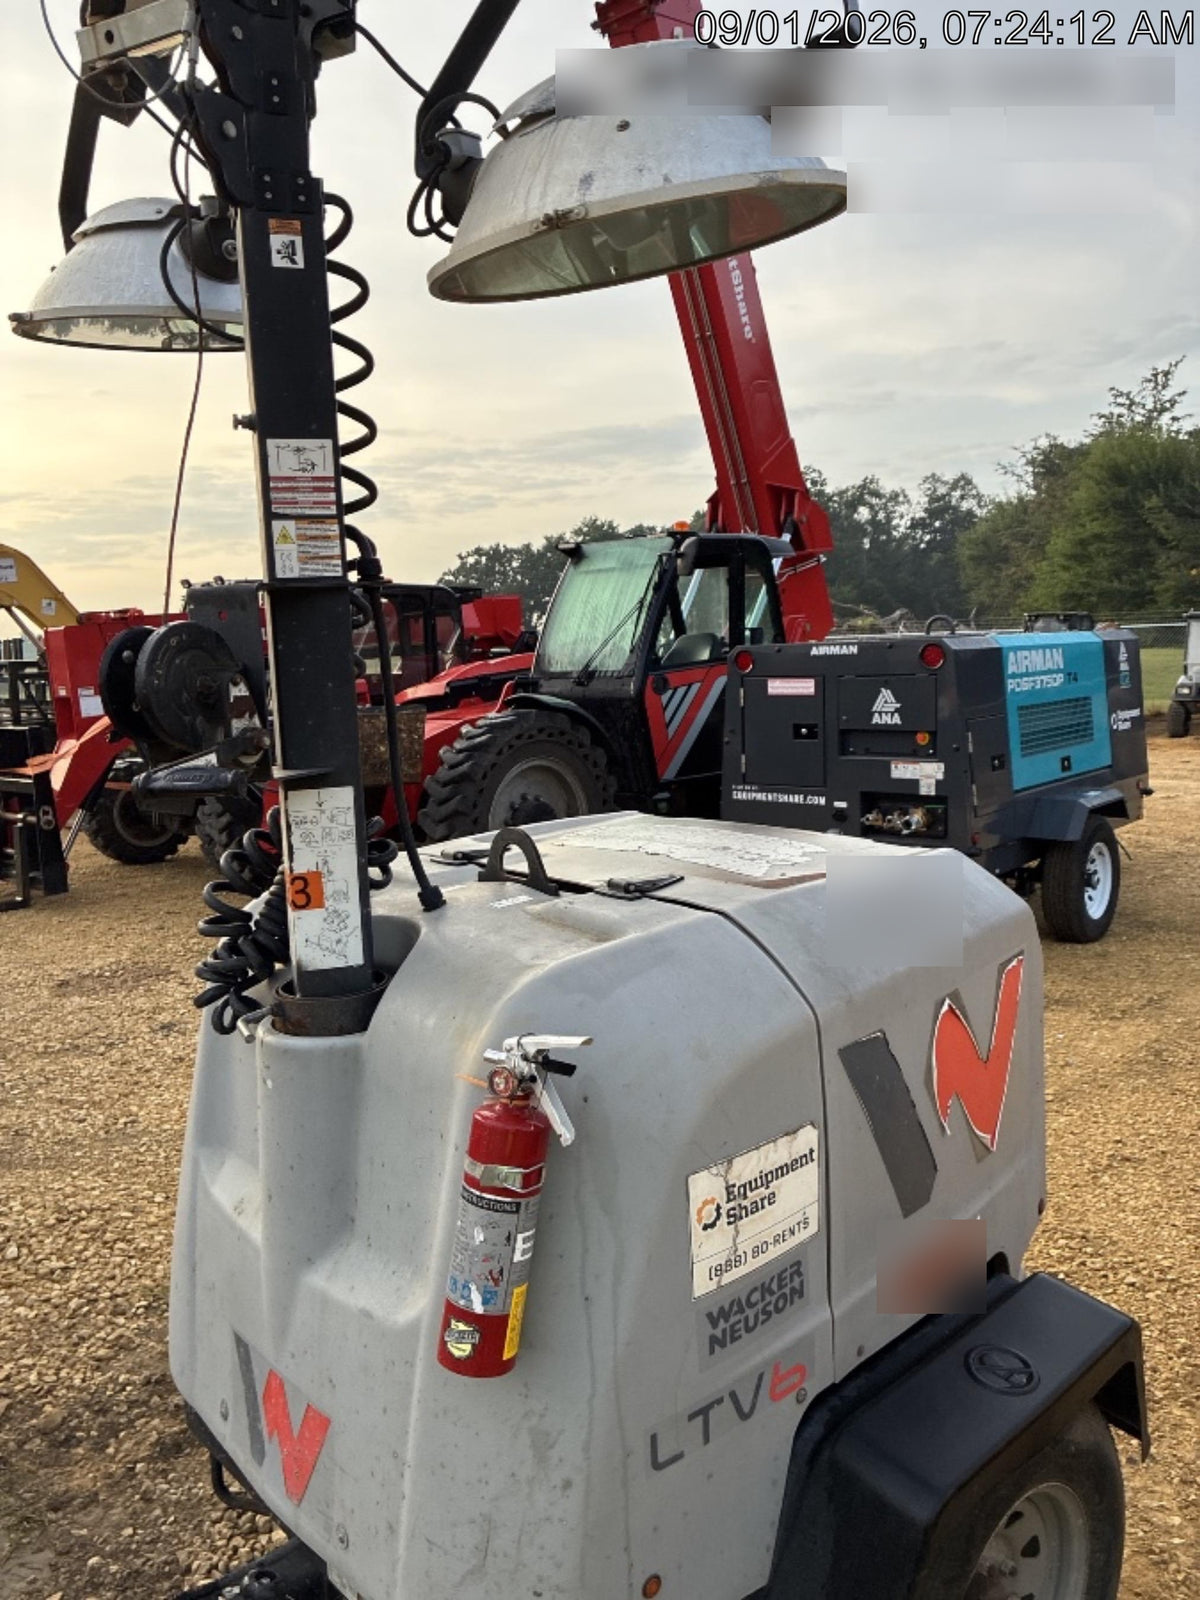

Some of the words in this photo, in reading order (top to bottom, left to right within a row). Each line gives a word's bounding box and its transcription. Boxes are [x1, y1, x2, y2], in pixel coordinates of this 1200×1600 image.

[727, 257, 753, 340] tShare
[810, 645, 858, 656] AIRMAN
[1007, 647, 1064, 674] AIRMAN
[871, 713, 902, 724] ANA
[289, 876, 312, 910] 3
[725, 1147, 816, 1204] Equipment
[725, 1191, 777, 1227] Share
[707, 1251, 748, 1282] (888)
[705, 1259, 804, 1331] WACKER
[708, 1278, 805, 1356] NEUSON
[650, 1360, 807, 1472] LTV6
